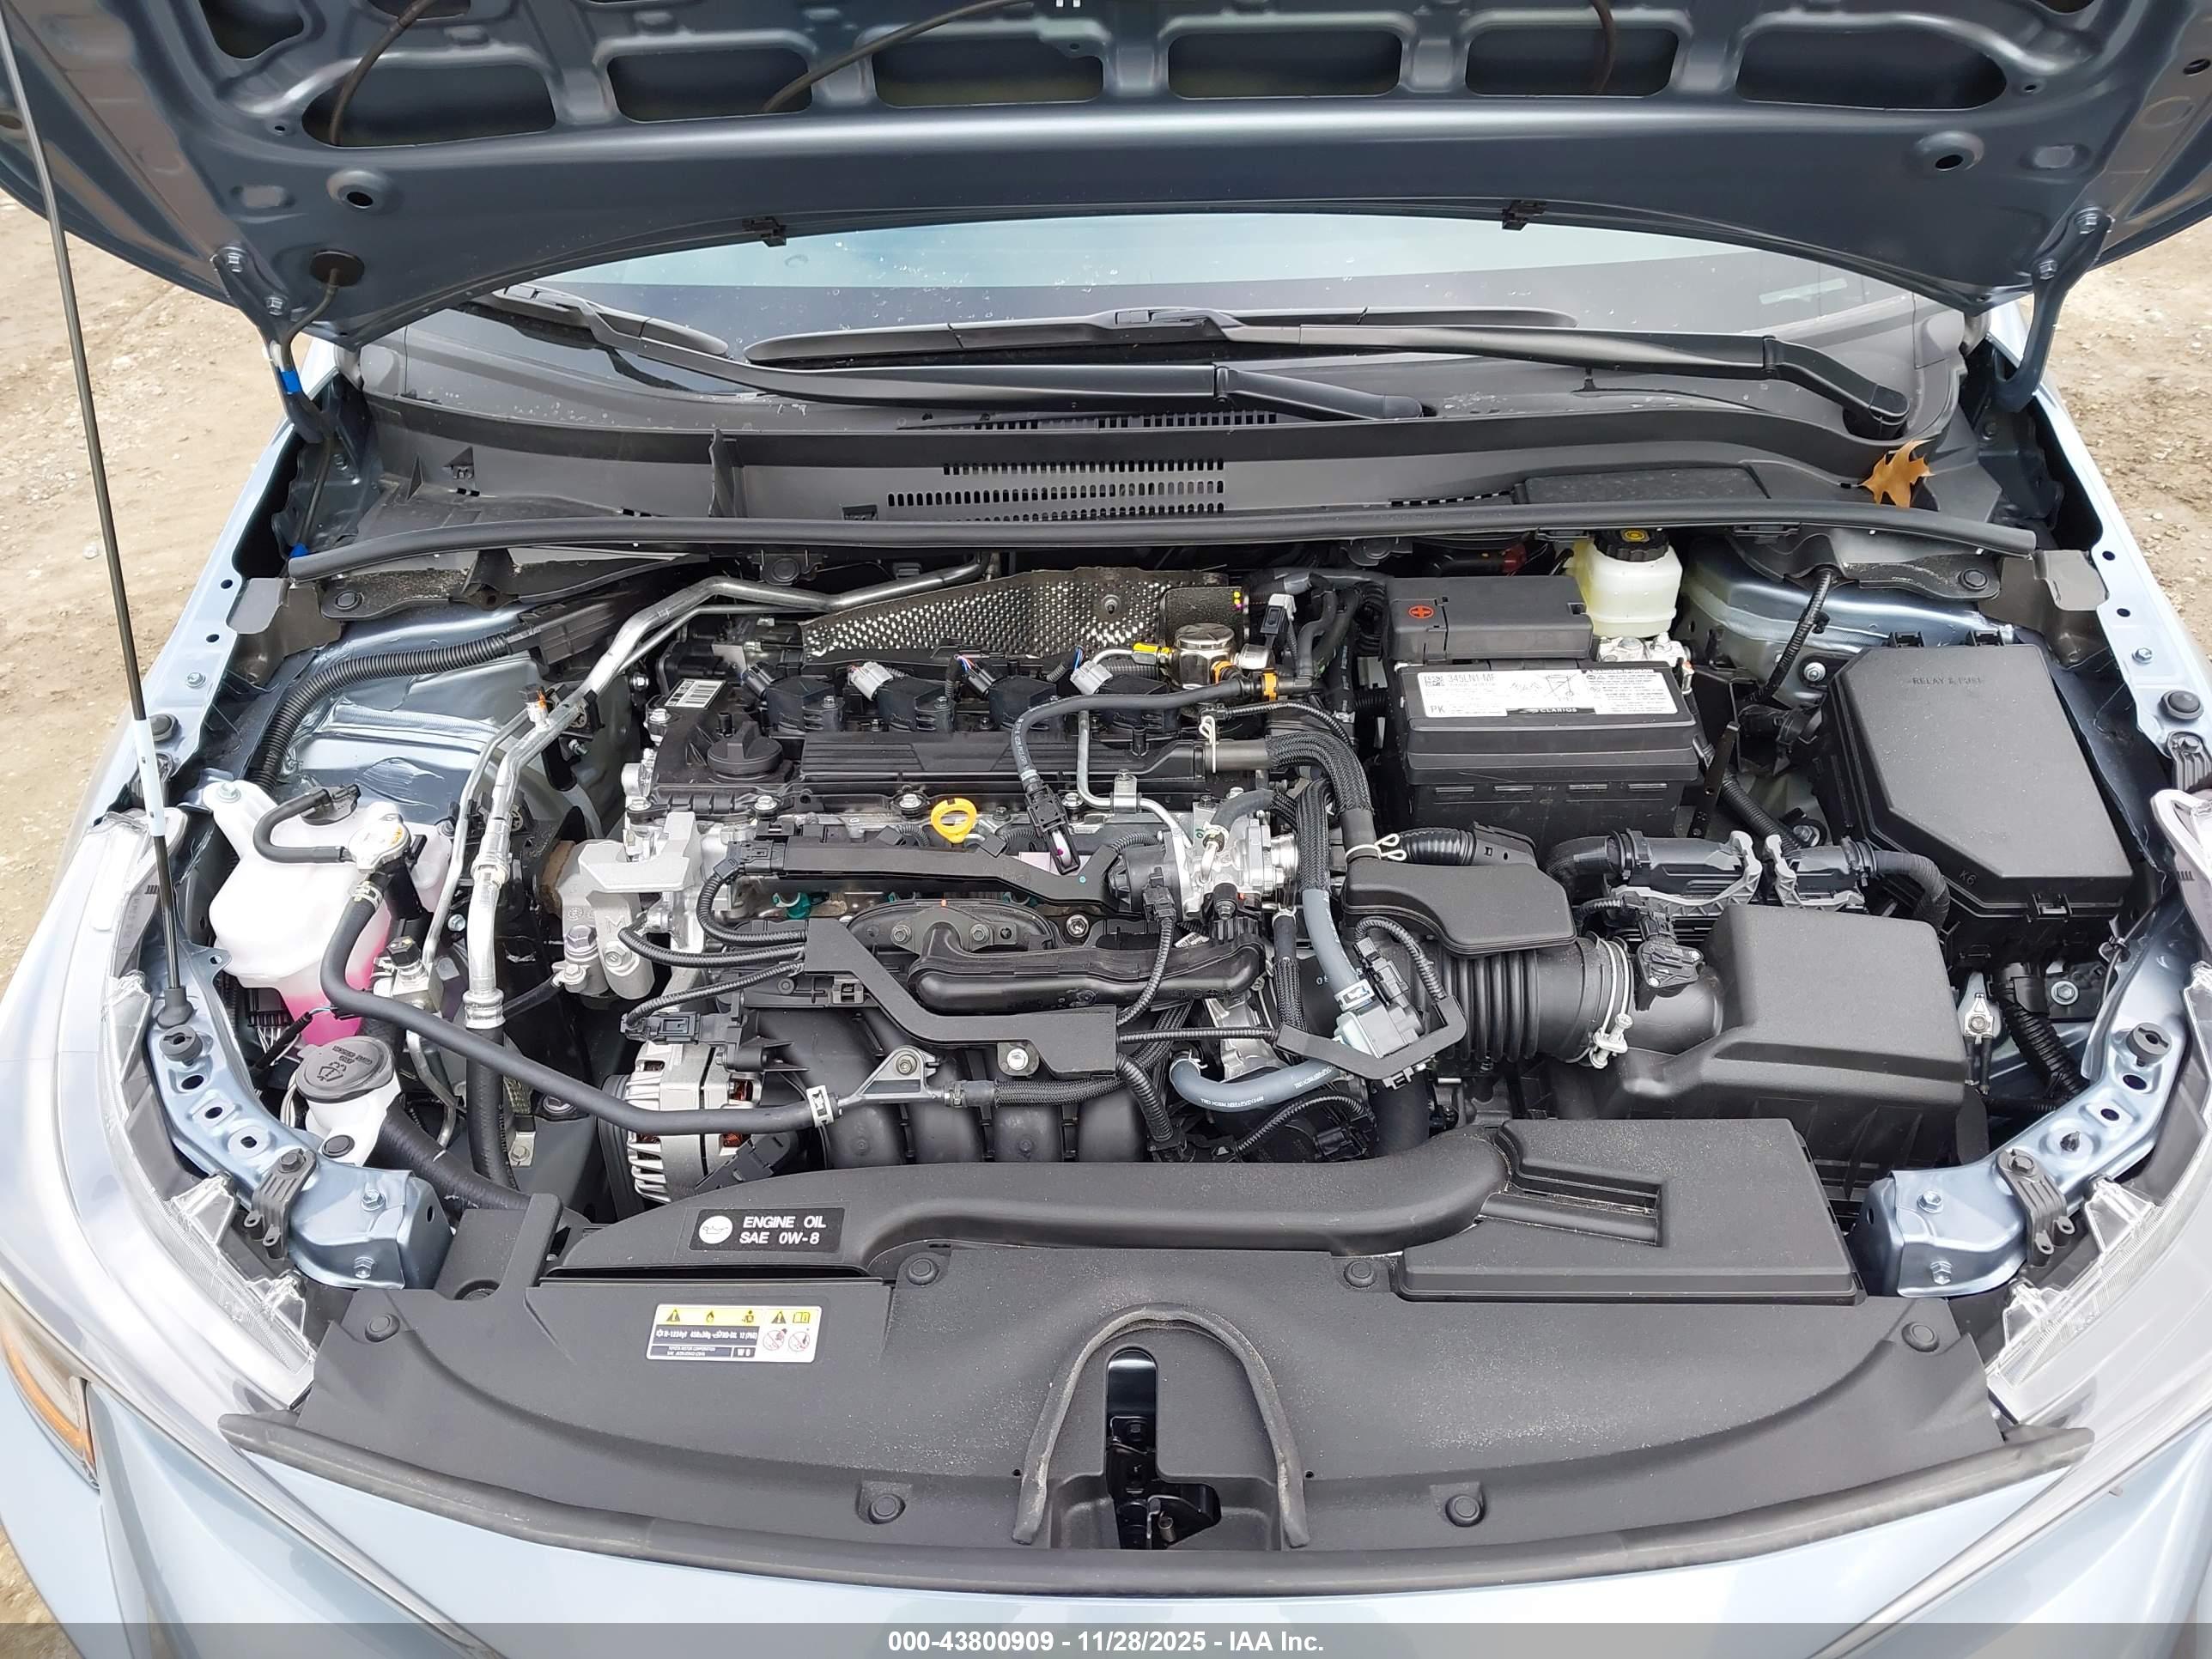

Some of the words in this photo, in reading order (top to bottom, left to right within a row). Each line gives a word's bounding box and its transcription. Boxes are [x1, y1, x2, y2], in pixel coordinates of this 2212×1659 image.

[743, 1216, 796, 1229] ENGINE
[804, 1215, 827, 1229] OIL
[739, 1231, 770, 1244] SAE
[779, 1231, 821, 1245] 0W-8
